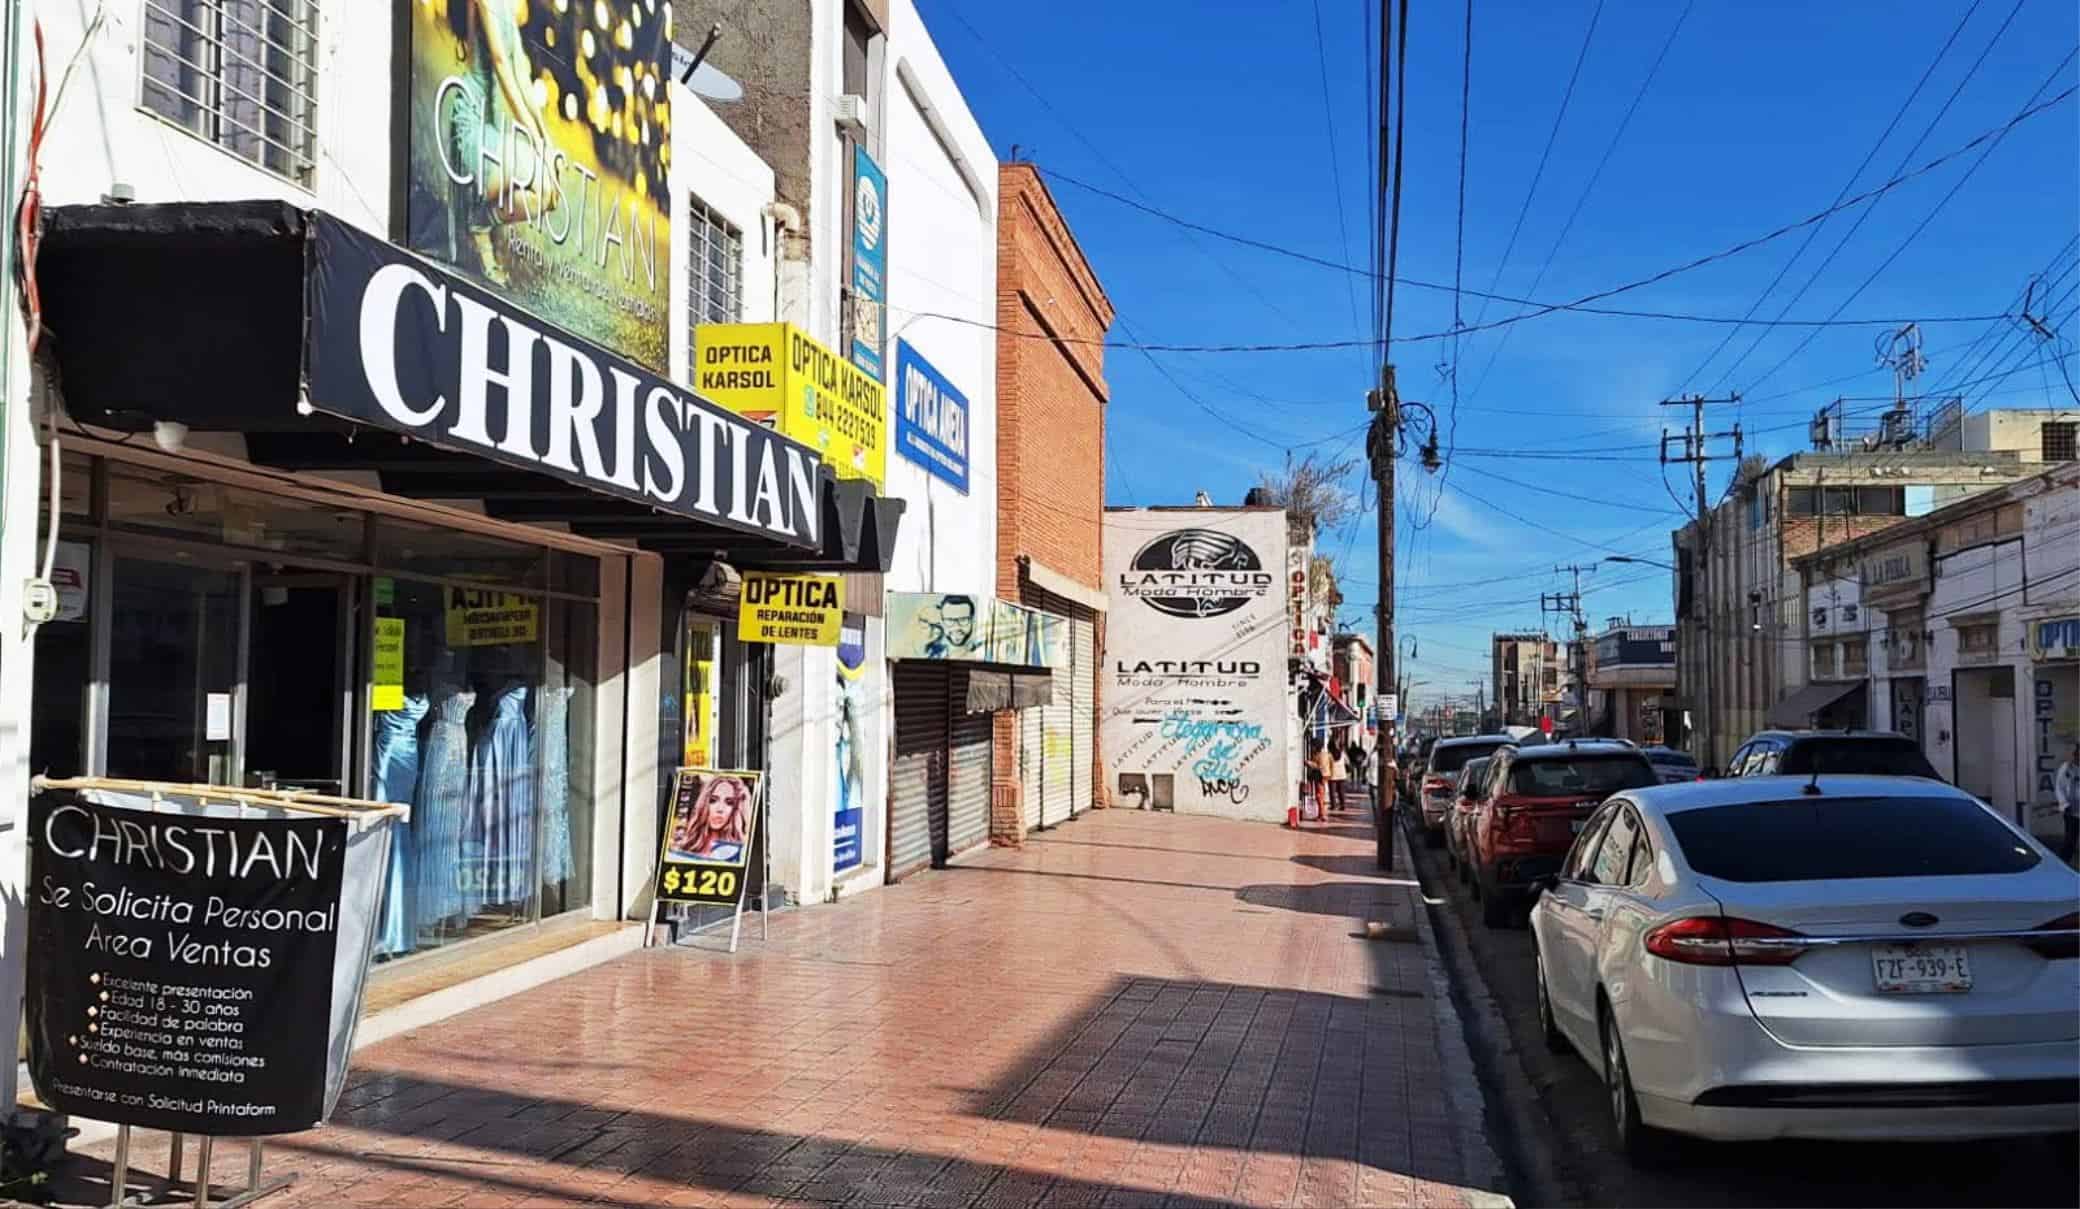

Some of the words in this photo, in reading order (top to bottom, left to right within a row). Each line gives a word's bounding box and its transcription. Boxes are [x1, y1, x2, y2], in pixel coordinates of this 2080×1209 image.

[435, 76, 657, 294] CHRISTIAN
[706, 345, 772, 364] OPTICA
[703, 370, 775, 389] KARSOL
[793, 333, 837, 389] OPTICA
[841, 366, 883, 423] KARSOL
[359, 263, 819, 541] CHRISTIAN
[746, 577, 838, 609] OPTICA
[1120, 573, 1272, 585] LATITUD
[1122, 588, 1177, 597] Moda
[1186, 588, 1267, 597] Hombre
[756, 608, 825, 625] REPARACIÓN
[761, 625, 778, 638] DE
[779, 626, 818, 641] LENTES
[1117, 660, 1261, 674] LATITUD
[1117, 678, 1164, 687] Moda
[1172, 678, 1248, 688] Hombre
[1112, 730, 1154, 770] LATITUD
[2035, 680, 2055, 793] OPTICA
[45, 805, 324, 880] CHRISTIAN
[664, 866, 736, 896] $120
[40, 875, 71, 908] Se
[82, 881, 194, 924] Solicita
[204, 896, 335, 932] Personal
[85, 922, 152, 958] Area
[168, 931, 272, 968] Ventas
[1876, 957, 1969, 980] FZF-939-E
[103, 971, 159, 994] Excelente
[161, 981, 253, 1001] presentación
[111, 990, 144, 1009] Edad
[149, 997, 165, 1011] 18
[181, 999, 201, 1014] 30
[205, 1003, 240, 1017] años
[100, 1004, 157, 1027] Facilidad
[162, 1014, 180, 1029] de
[184, 1017, 244, 1034] palabra
[79, 1034, 120, 1054] Sueldo
[162, 1048, 189, 1062] más
[194, 1051, 265, 1068] comisiones
[100, 1022, 172, 1046] Experiencia
[177, 1034, 194, 1046] en
[199, 1034, 243, 1050] ventas
[90, 1053, 174, 1076] Contratación
[52, 1079, 117, 1103] Presentarse
[120, 1092, 144, 1106] con
[147, 1094, 203, 1114] Solicitud
[207, 1099, 276, 1117] Printaform
